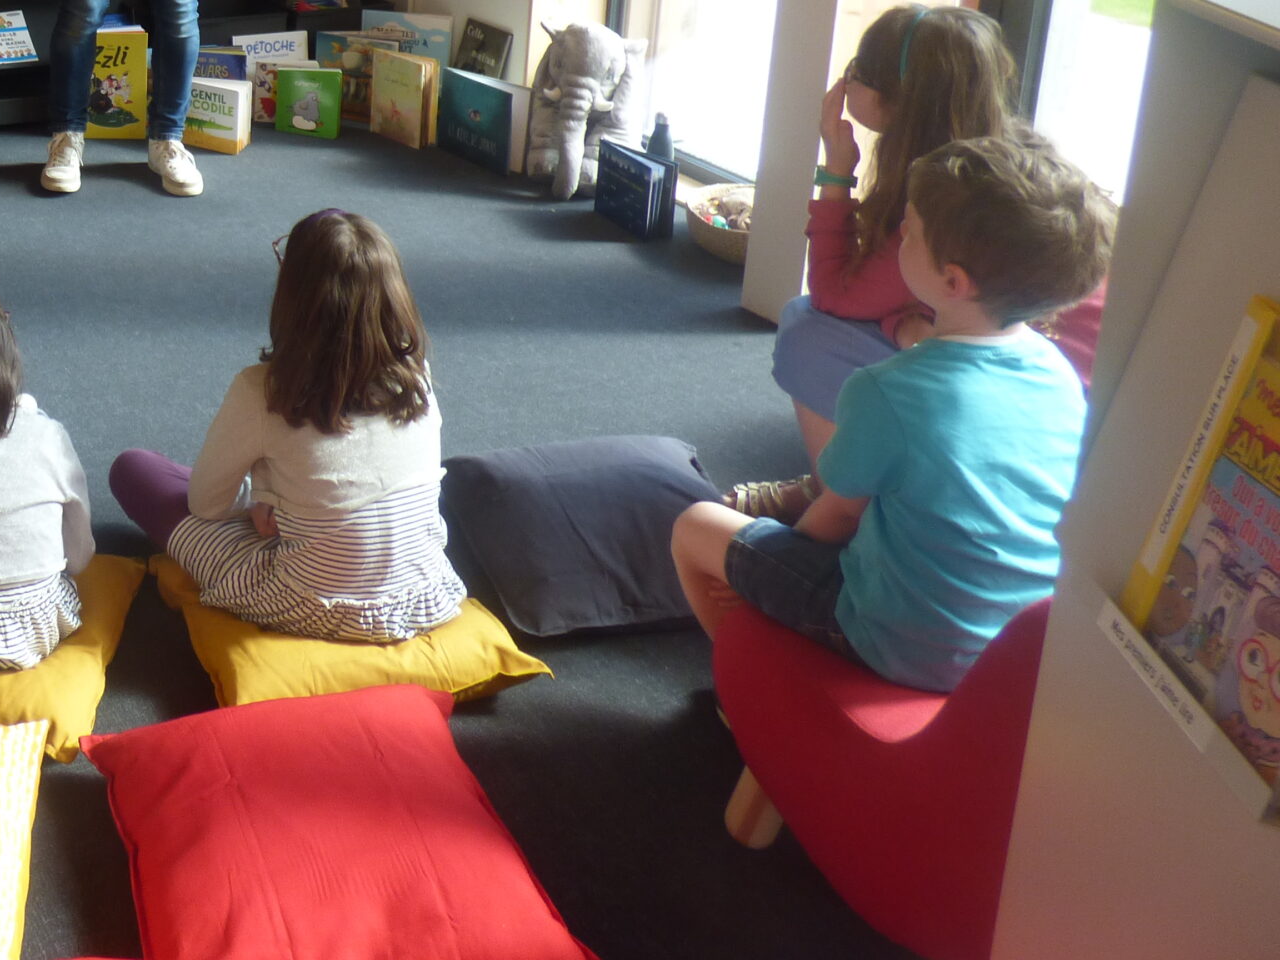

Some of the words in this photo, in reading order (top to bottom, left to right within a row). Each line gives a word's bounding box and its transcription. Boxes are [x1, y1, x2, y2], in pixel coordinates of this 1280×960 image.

[246, 40, 296, 55] PÉTOCHE
[191, 89, 227, 105] GENTIL
[191, 100, 234, 117] CODILE
[1159, 433, 1205, 534] CONSULTATION
[1203, 402, 1219, 432] SUR
[1216, 354, 1239, 397] PLACE
